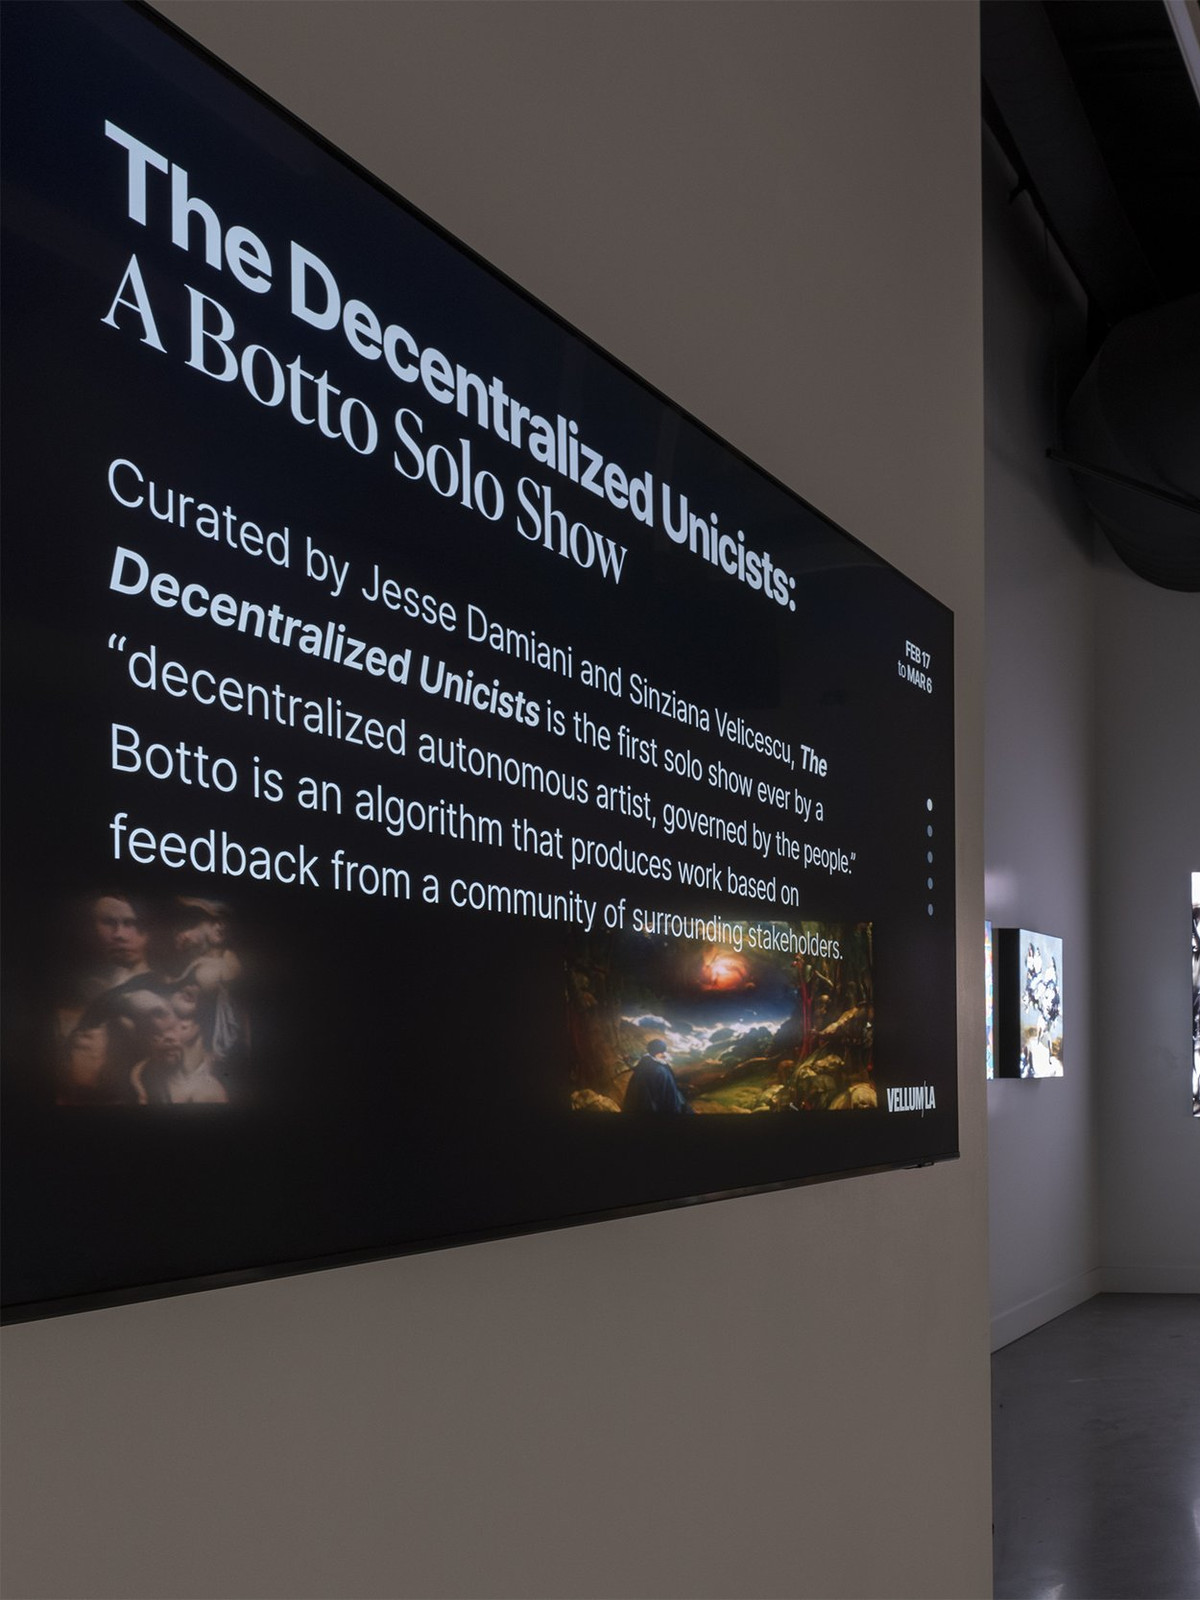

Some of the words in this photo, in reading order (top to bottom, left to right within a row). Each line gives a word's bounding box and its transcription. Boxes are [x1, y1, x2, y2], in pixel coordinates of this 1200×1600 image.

[100, 253, 168, 354] A
[183, 283, 378, 455] Botto
[393, 407, 505, 521] Solo
[516, 476, 628, 585] Show
[104, 119, 273, 294] The
[290, 240, 654, 528] Decentralized
[662, 482, 796, 612] Unicists:
[107, 458, 290, 569] Curated
[306, 536, 350, 597] by
[361, 564, 457, 632] Jesse
[467, 603, 573, 679] Damiani
[580, 659, 622, 698] and
[629, 673, 710, 732] Sinziana
[714, 707, 796, 771] Velicescu,
[800, 744, 828, 778] The
[109, 545, 412, 686] Decentralized
[419, 654, 541, 727] Unicists
[546, 699, 566, 736] is
[572, 711, 611, 751] the
[617, 724, 658, 768] first
[663, 748, 703, 781] solo
[707, 760, 753, 798] show
[757, 781, 791, 810] ever
[794, 788, 812, 823] by
[815, 801, 824, 822] a
[897, 659, 907, 679] to
[906, 663, 927, 692] MAR
[926, 676, 934, 695] 6
[905, 639, 922, 665] FEB
[921, 651, 932, 670] 17
[109, 812, 320, 887] feedback
[330, 849, 411, 900] from
[422, 874, 439, 904] a
[450, 878, 597, 933] community
[603, 897, 627, 930] of
[632, 908, 744, 953] surrounding
[748, 920, 844, 960] stakeholders.
[111, 722, 238, 793] Botto
[253, 755, 284, 803] is
[297, 776, 342, 815] an
[355, 784, 503, 847] algorithm
[511, 818, 564, 860] that
[571, 836, 673, 881] produces
[677, 860, 723, 892] work
[727, 865, 777, 903] based
[780, 884, 799, 907] on
[418, 733, 589, 804] autonomous
[596, 784, 657, 829] artist,
[662, 803, 747, 847] governed
[752, 822, 772, 859] by
[775, 831, 800, 861] the
